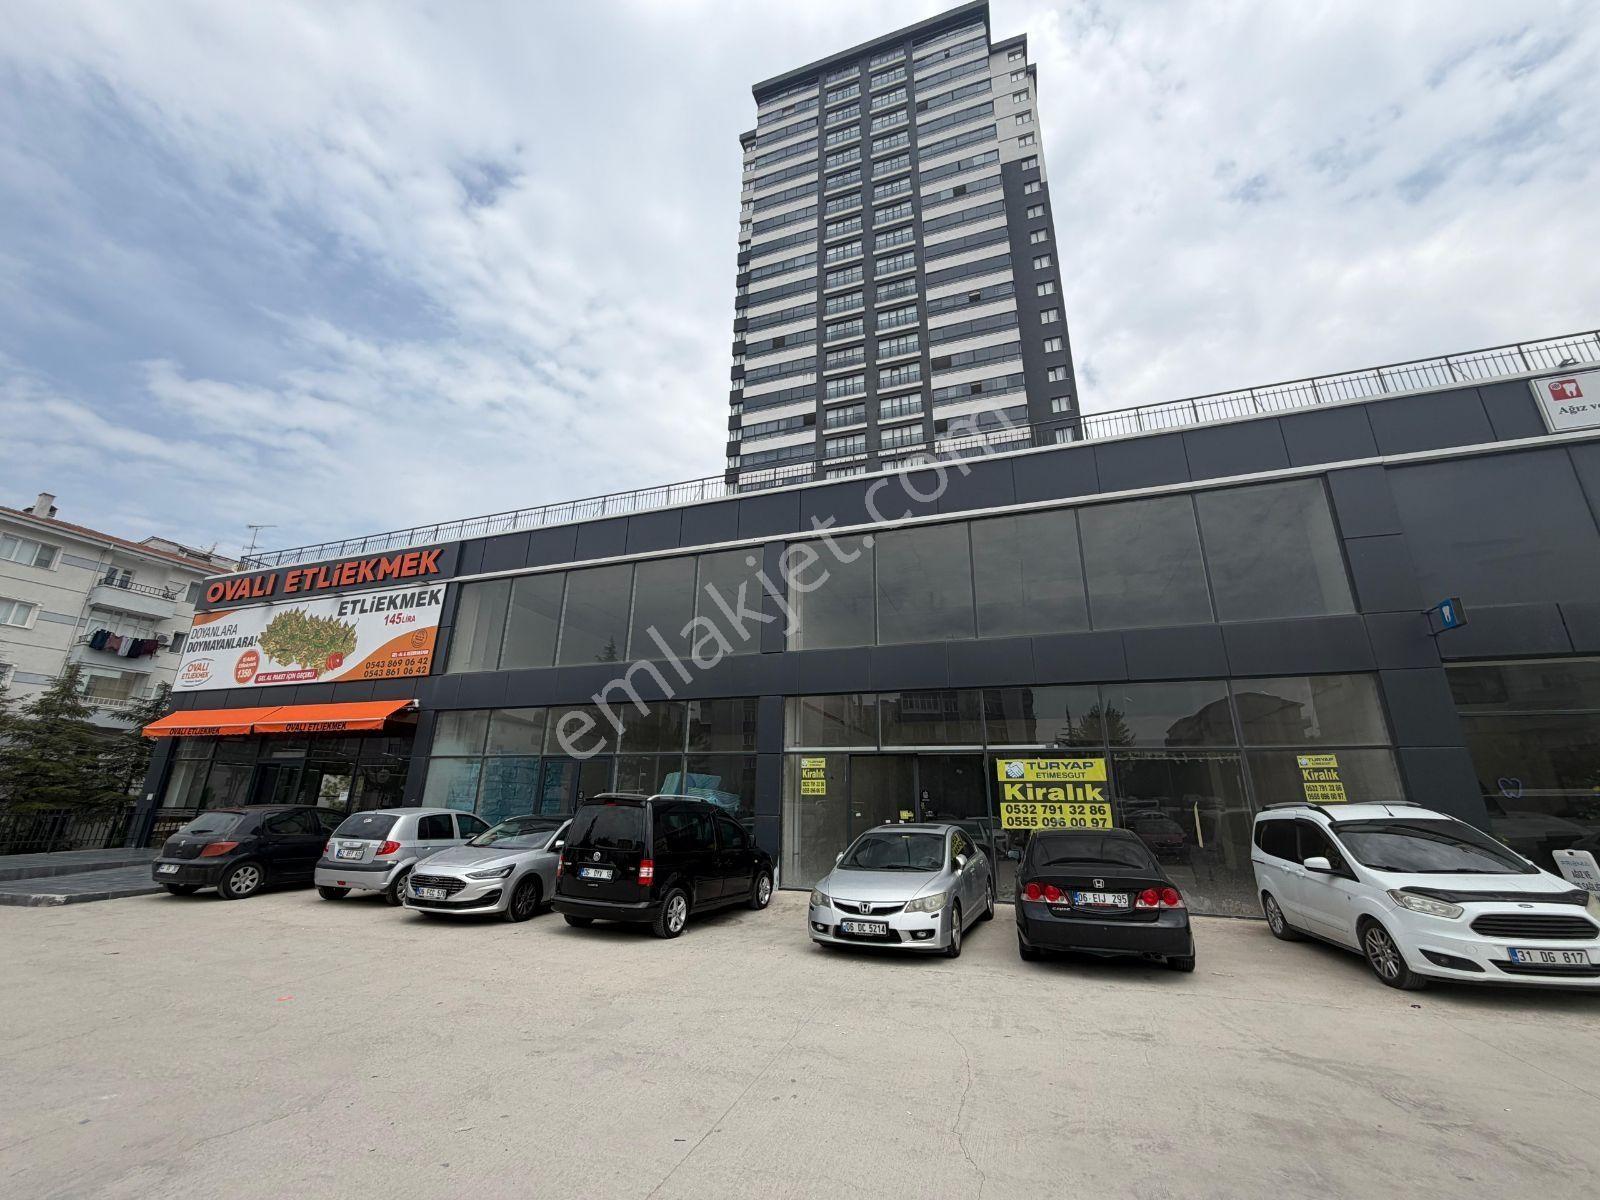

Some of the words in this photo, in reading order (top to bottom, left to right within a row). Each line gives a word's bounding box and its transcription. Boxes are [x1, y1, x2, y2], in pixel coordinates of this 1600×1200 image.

[1560, 404, 1588, 415] Ağız
[206, 574, 276, 603] OVALI
[190, 624, 238, 639] DOYANLARA
[186, 635, 259, 653] DOYMAYANLARA!
[365, 661, 385, 670] 0543
[387, 659, 403, 668] 869
[405, 658, 415, 666] 06
[417, 657, 428, 665] 42
[363, 669, 383, 678] 0543
[385, 668, 400, 677] 861
[403, 667, 413, 675] 06
[416, 666, 427, 674] 42
[1026, 761, 1094, 770] TURYAP
[802, 769, 825, 779] Kiralık
[1302, 769, 1340, 780] Kiralık
[1004, 783, 1105, 801] Kiralık
[1005, 804, 1037, 815] 0532
[1041, 804, 1064, 815] 791
[1069, 804, 1085, 815] 32
[1089, 805, 1106, 816] 86
[1006, 816, 1038, 827] 0555
[1042, 817, 1067, 827] 096
[1070, 817, 1087, 827] 00
[1091, 818, 1107, 828] 97
[1078, 893, 1088, 902] 06
[1112, 894, 1127, 904] 295
[869, 924, 886, 933] 5214
[1518, 951, 1532, 962] 31
[1563, 952, 1584, 964] 817
